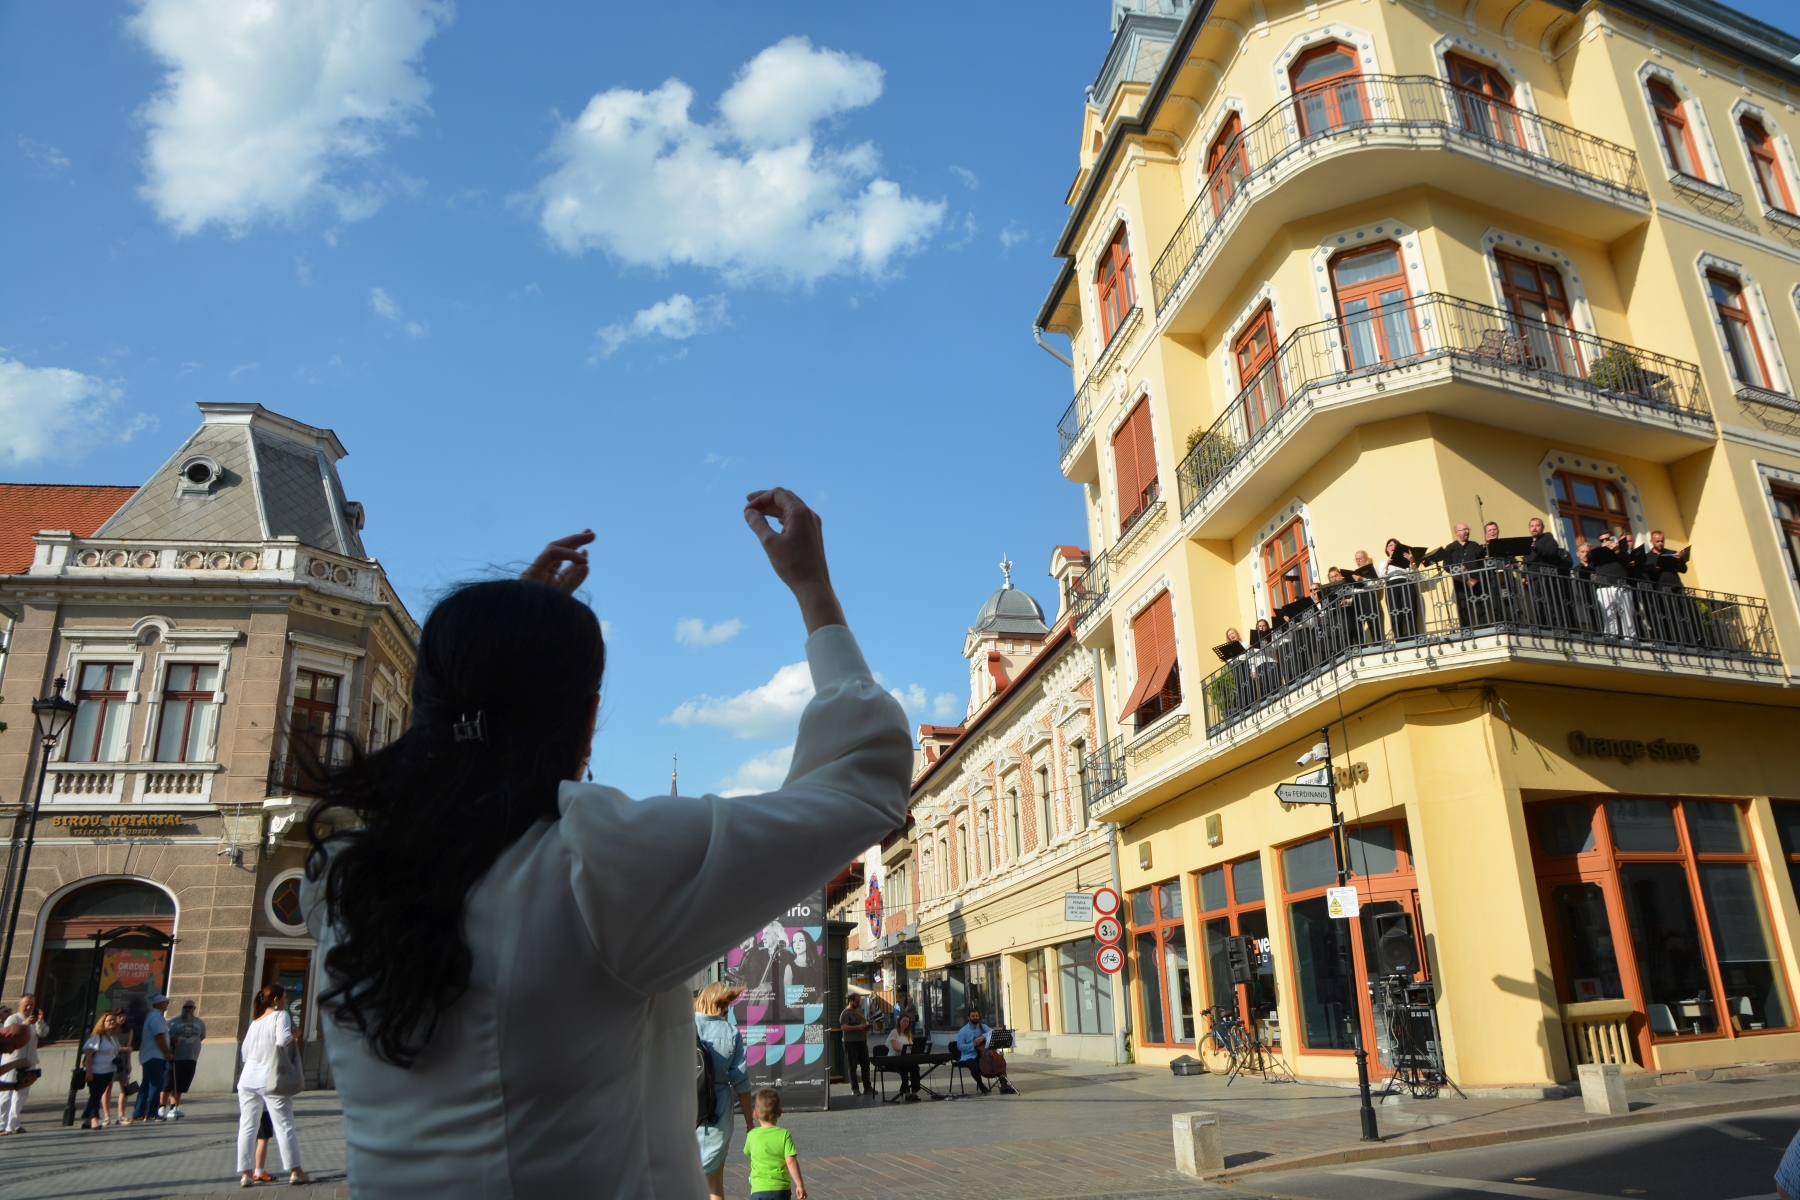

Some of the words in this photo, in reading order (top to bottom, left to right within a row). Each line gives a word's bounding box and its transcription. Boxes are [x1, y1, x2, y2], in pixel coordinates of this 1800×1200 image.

[1568, 731, 1646, 762] Orange
[1648, 738, 1700, 761] store
[1333, 762, 1366, 789] tore
[52, 815, 101, 827] BIROU
[109, 814, 183, 826] NOTARIAL
[116, 970, 130, 978] CITY
[131, 970, 149, 978] HUNT
